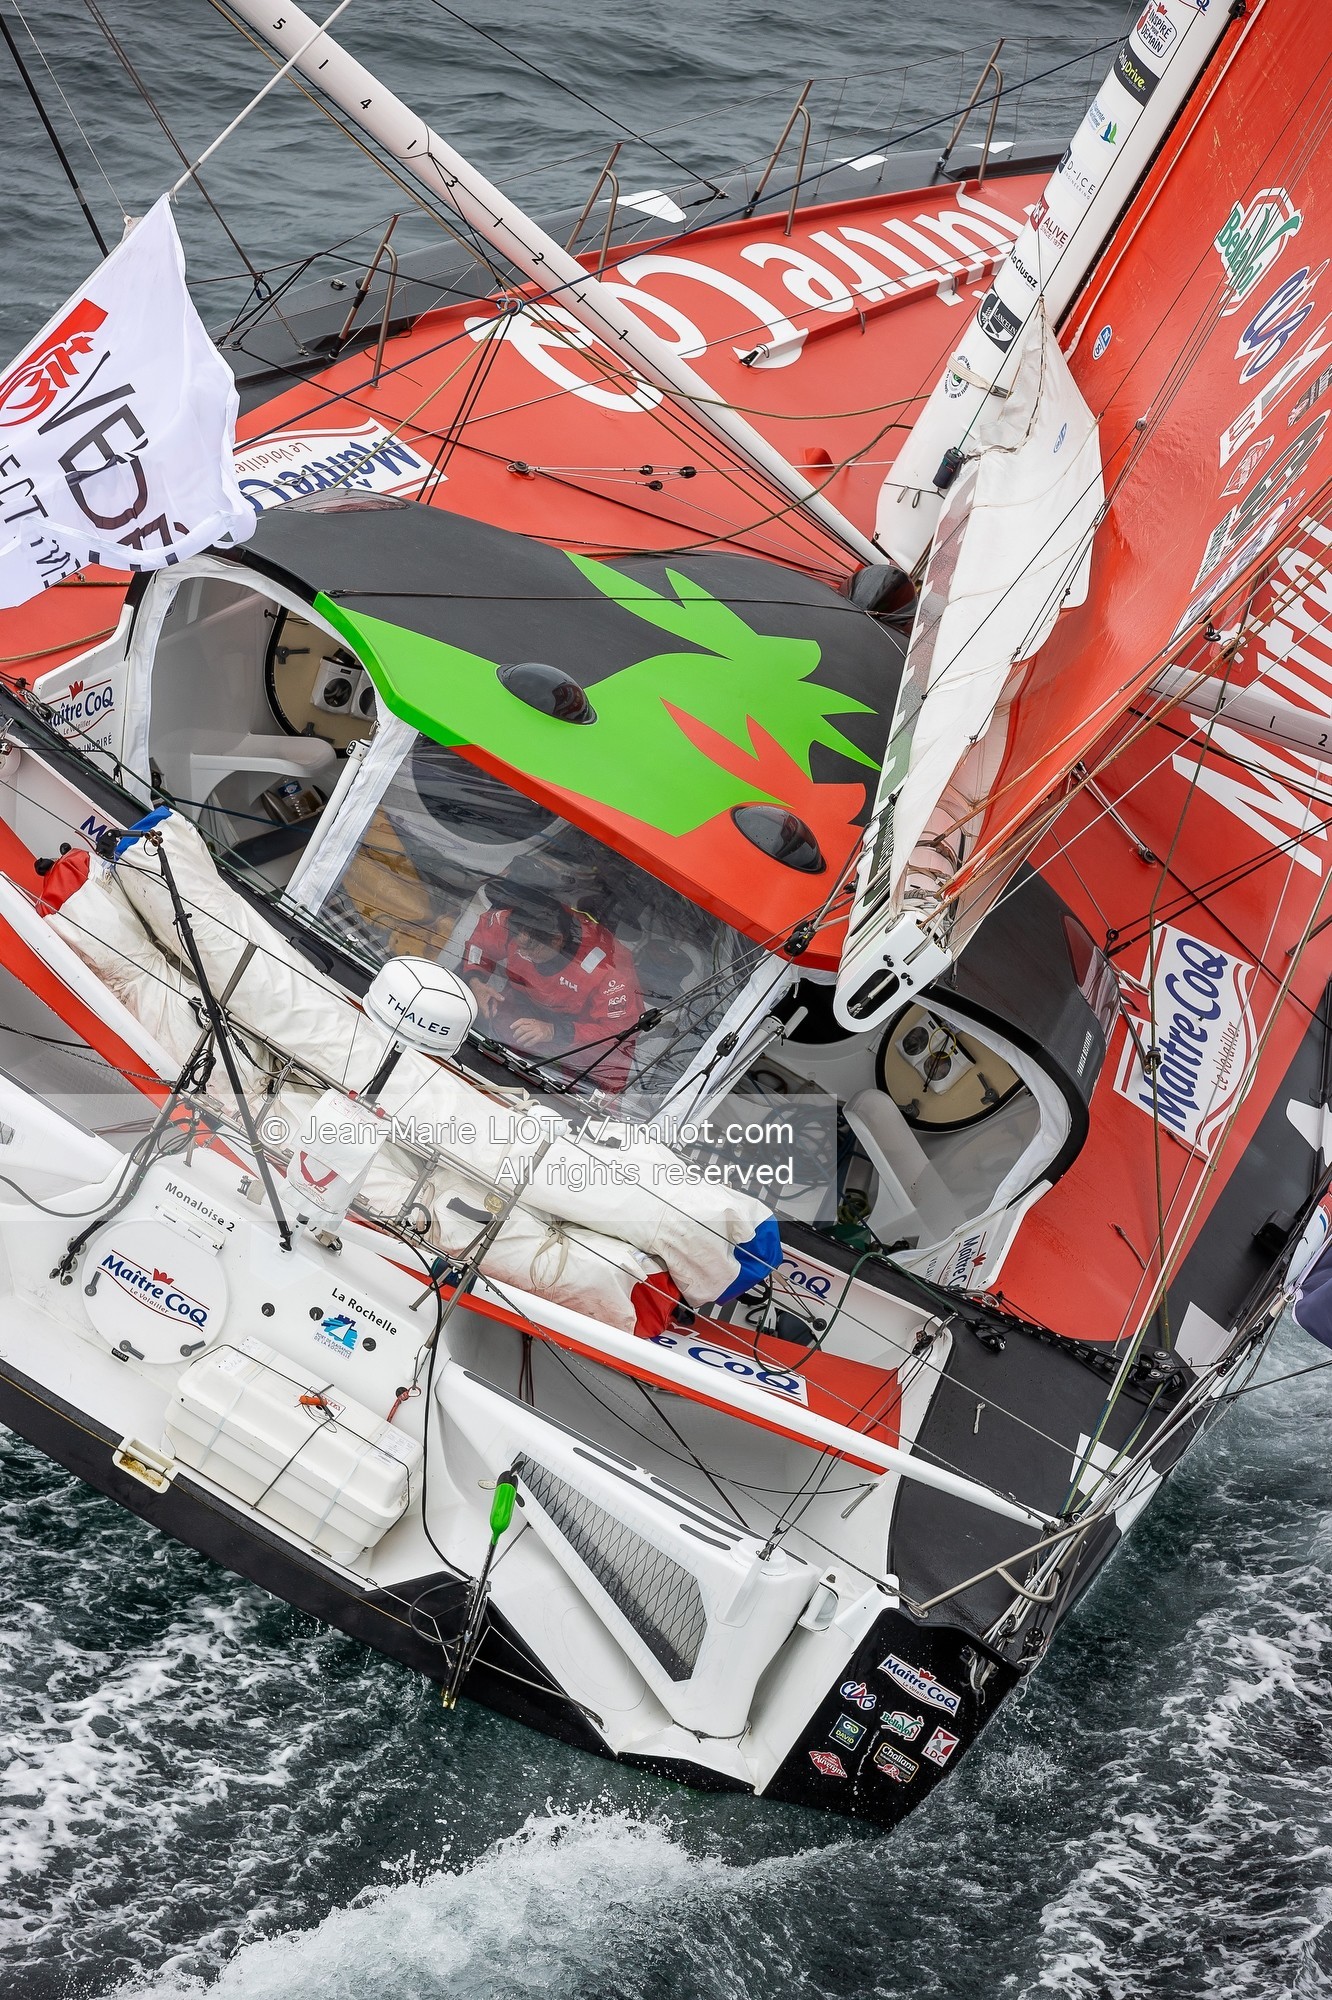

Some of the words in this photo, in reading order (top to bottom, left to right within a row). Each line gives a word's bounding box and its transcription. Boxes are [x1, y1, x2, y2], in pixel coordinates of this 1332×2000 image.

[272, 17, 287, 31] 5
[360, 98, 373, 109] 4
[446, 175, 459, 188] 3
[1067, 161, 1096, 195] D-ICE
[1043, 217, 1068, 245] ALIVE
[532, 252, 545, 265] 2
[994, 307, 1018, 335] LANCELIN
[48, 702, 82, 727] aître
[85, 686, 114, 716] CoQ
[1165, 937, 1228, 1020] CoQ
[388, 994, 451, 1036] THALES
[1139, 1013, 1208, 1133] Maître
[165, 1182, 224, 1225] Monaloise
[226, 1222, 235, 1233] 2
[953, 1235, 980, 1277] Maître
[101, 1254, 164, 1299] Maître
[165, 1293, 208, 1327] CoQ
[129, 1287, 139, 1296] Le
[138, 1292, 170, 1314] Volailler
[331, 1287, 346, 1302] La
[347, 1298, 397, 1336] Rochelle
[687, 1346, 801, 1395] CoQ
[883, 1657, 927, 1691] Maître
[926, 1685, 957, 1710] CoQ
[835, 1729, 855, 1745] DAVID
[924, 1747, 945, 1766] LDC
